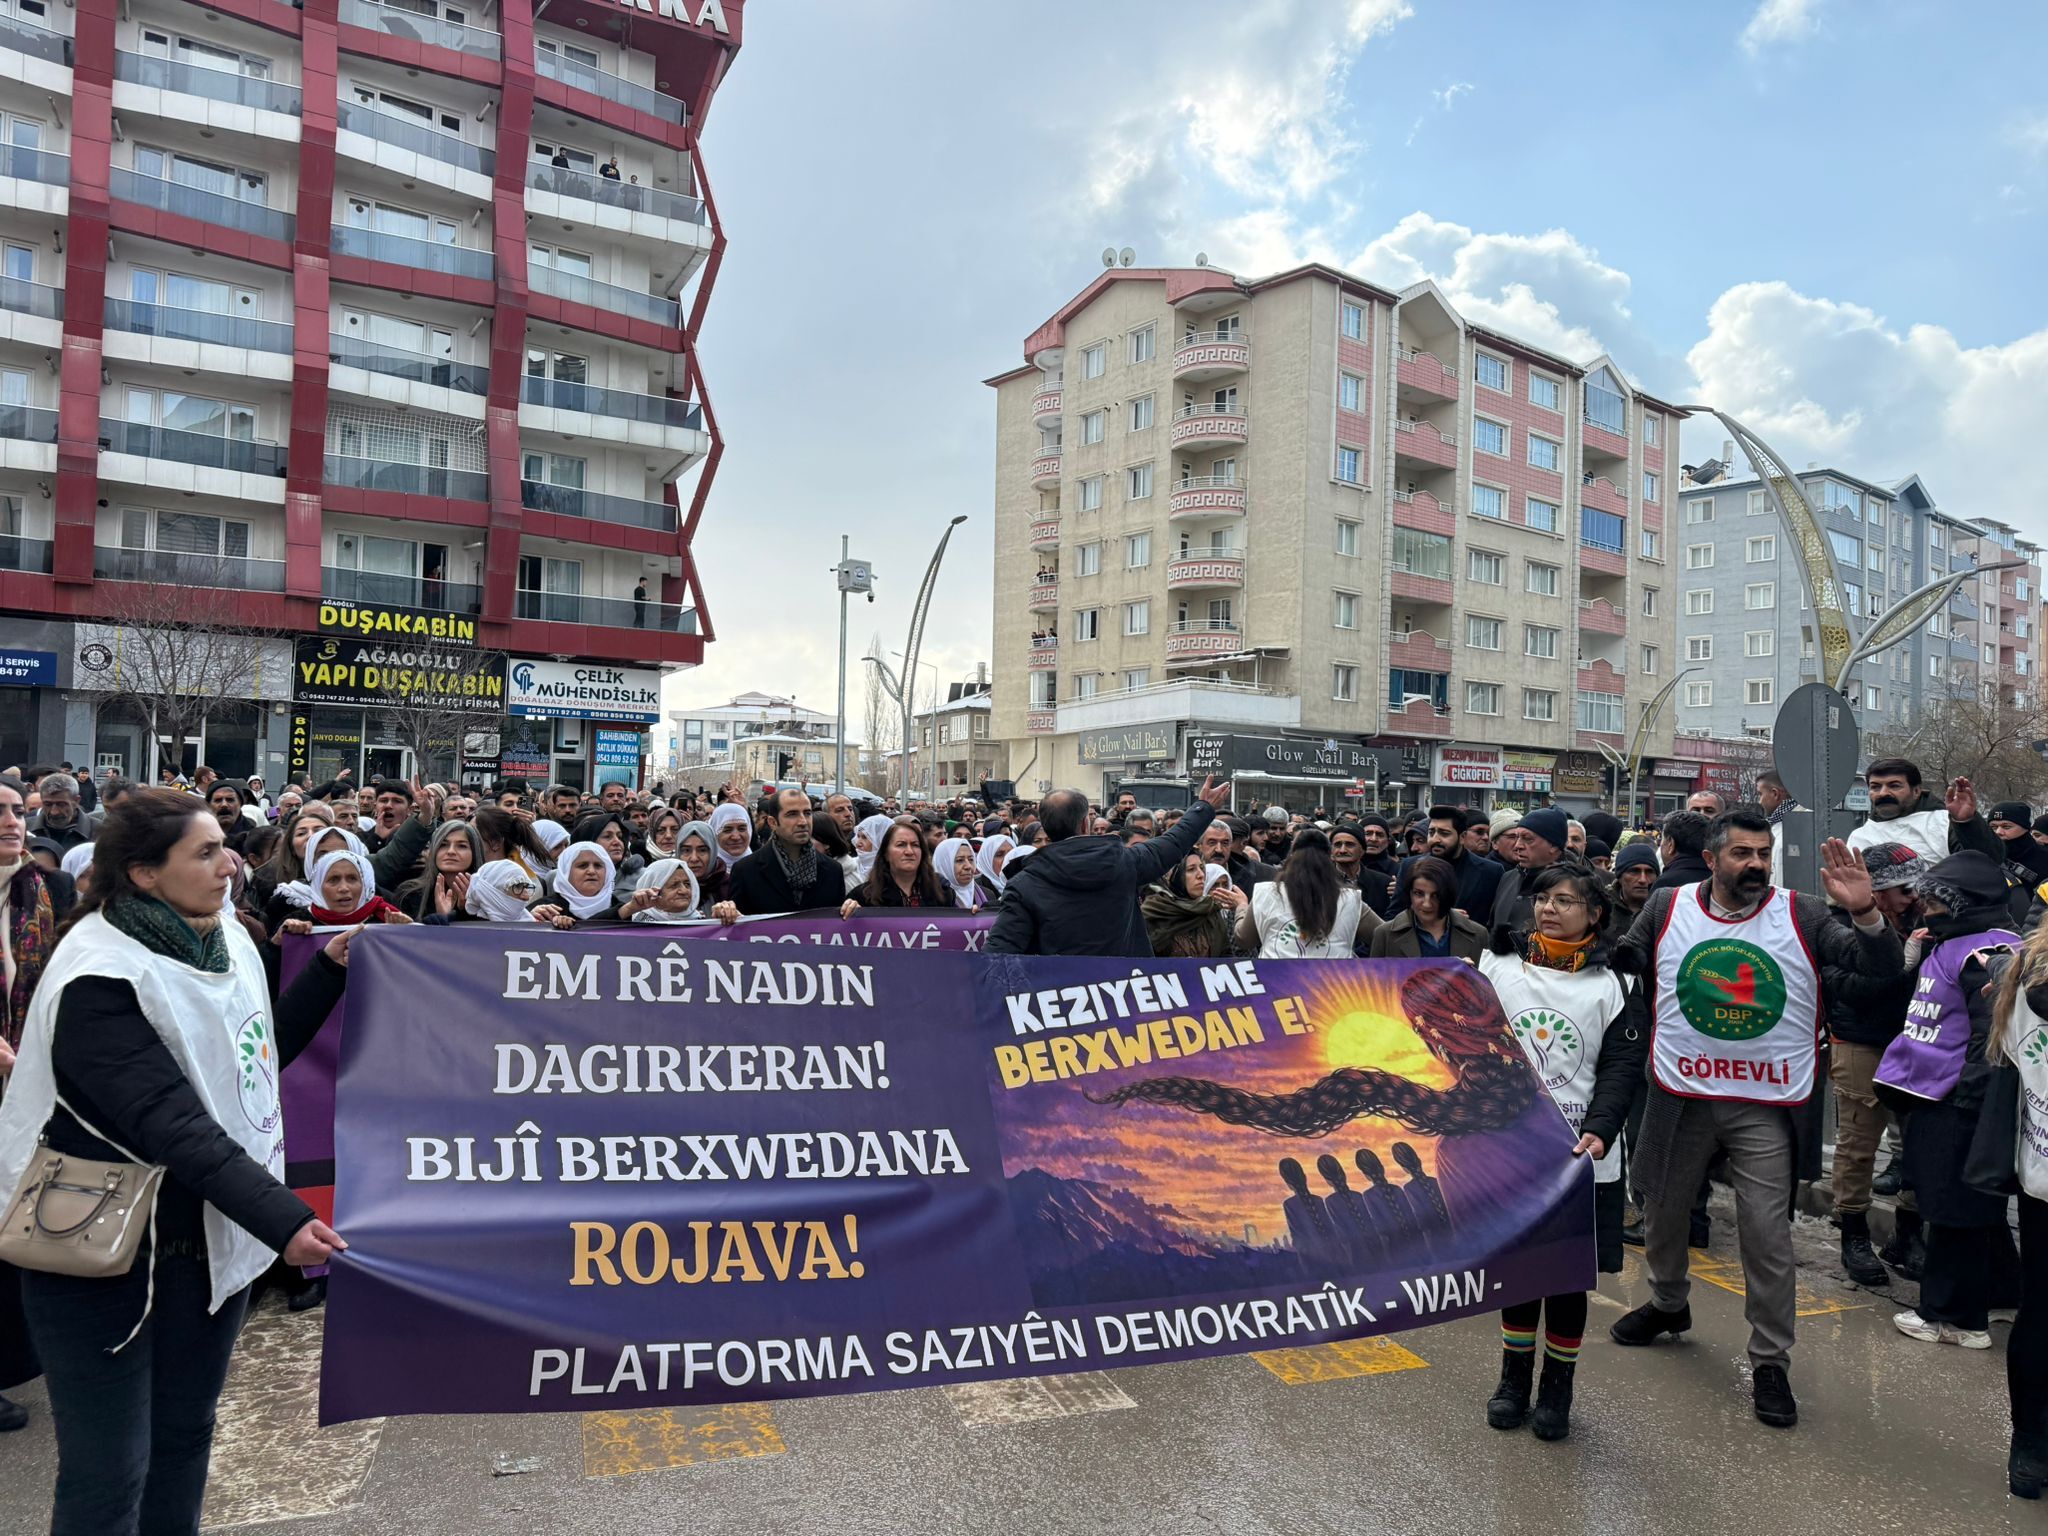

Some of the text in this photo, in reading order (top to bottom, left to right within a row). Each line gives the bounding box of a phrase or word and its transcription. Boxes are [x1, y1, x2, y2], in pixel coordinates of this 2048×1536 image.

[322, 599, 355, 608] AĞAOĞLU
[319, 605, 474, 639] DUŞAKABİN
[5, 657, 40, 668] SERVİS
[354, 642, 461, 669] AĞAOĞLU
[15, 668, 29, 676] 87
[300, 661, 356, 688] YAPI
[363, 667, 502, 697] DUŞAKABİN
[574, 668, 624, 685] ÇELİK
[465, 695, 501, 708] FİRMA
[510, 695, 563, 705] DOĞALGAZ
[536, 682, 658, 704] MÜHENDİSLİK
[292, 716, 306, 766] BANYO
[312, 734, 334, 743] ANYO
[1099, 729, 1168, 752] Glow Nail Bar's
[1193, 739, 1223, 748] Glow
[617, 743, 639, 754] DÜKKAN
[1196, 748, 1219, 757] Nail
[1266, 744, 1379, 767] Glow Nail Bar's
[1441, 748, 1499, 764] MEZOPOTAMYA
[465, 761, 497, 769] AĞAOĞLU
[596, 754, 610, 762] 0543
[622, 755, 629, 763] 52
[1192, 757, 1223, 767] Bar's
[1558, 768, 1585, 777] STUDIO
[502, 941, 875, 1007] EM RÊ NADIN
[1005, 960, 1266, 1036] KEZIYÊN ME
[1714, 1007, 1752, 1020] DBP
[994, 995, 1316, 1090] BERXWEDAN E!
[492, 1040, 891, 1094] DAGIRKERAN!
[1677, 1053, 1790, 1085] GÖREVLİ
[406, 1120, 970, 1182] BIJÎ BERXWEDANA
[568, 1214, 865, 1286] ROJAVA!
[528, 1333, 876, 1397] PLATFORMA
[885, 1310, 1089, 1376] SAZIYÊN
[1094, 1280, 1378, 1357] DEMOKRATÎK
[1400, 1268, 1486, 1317] WAN
